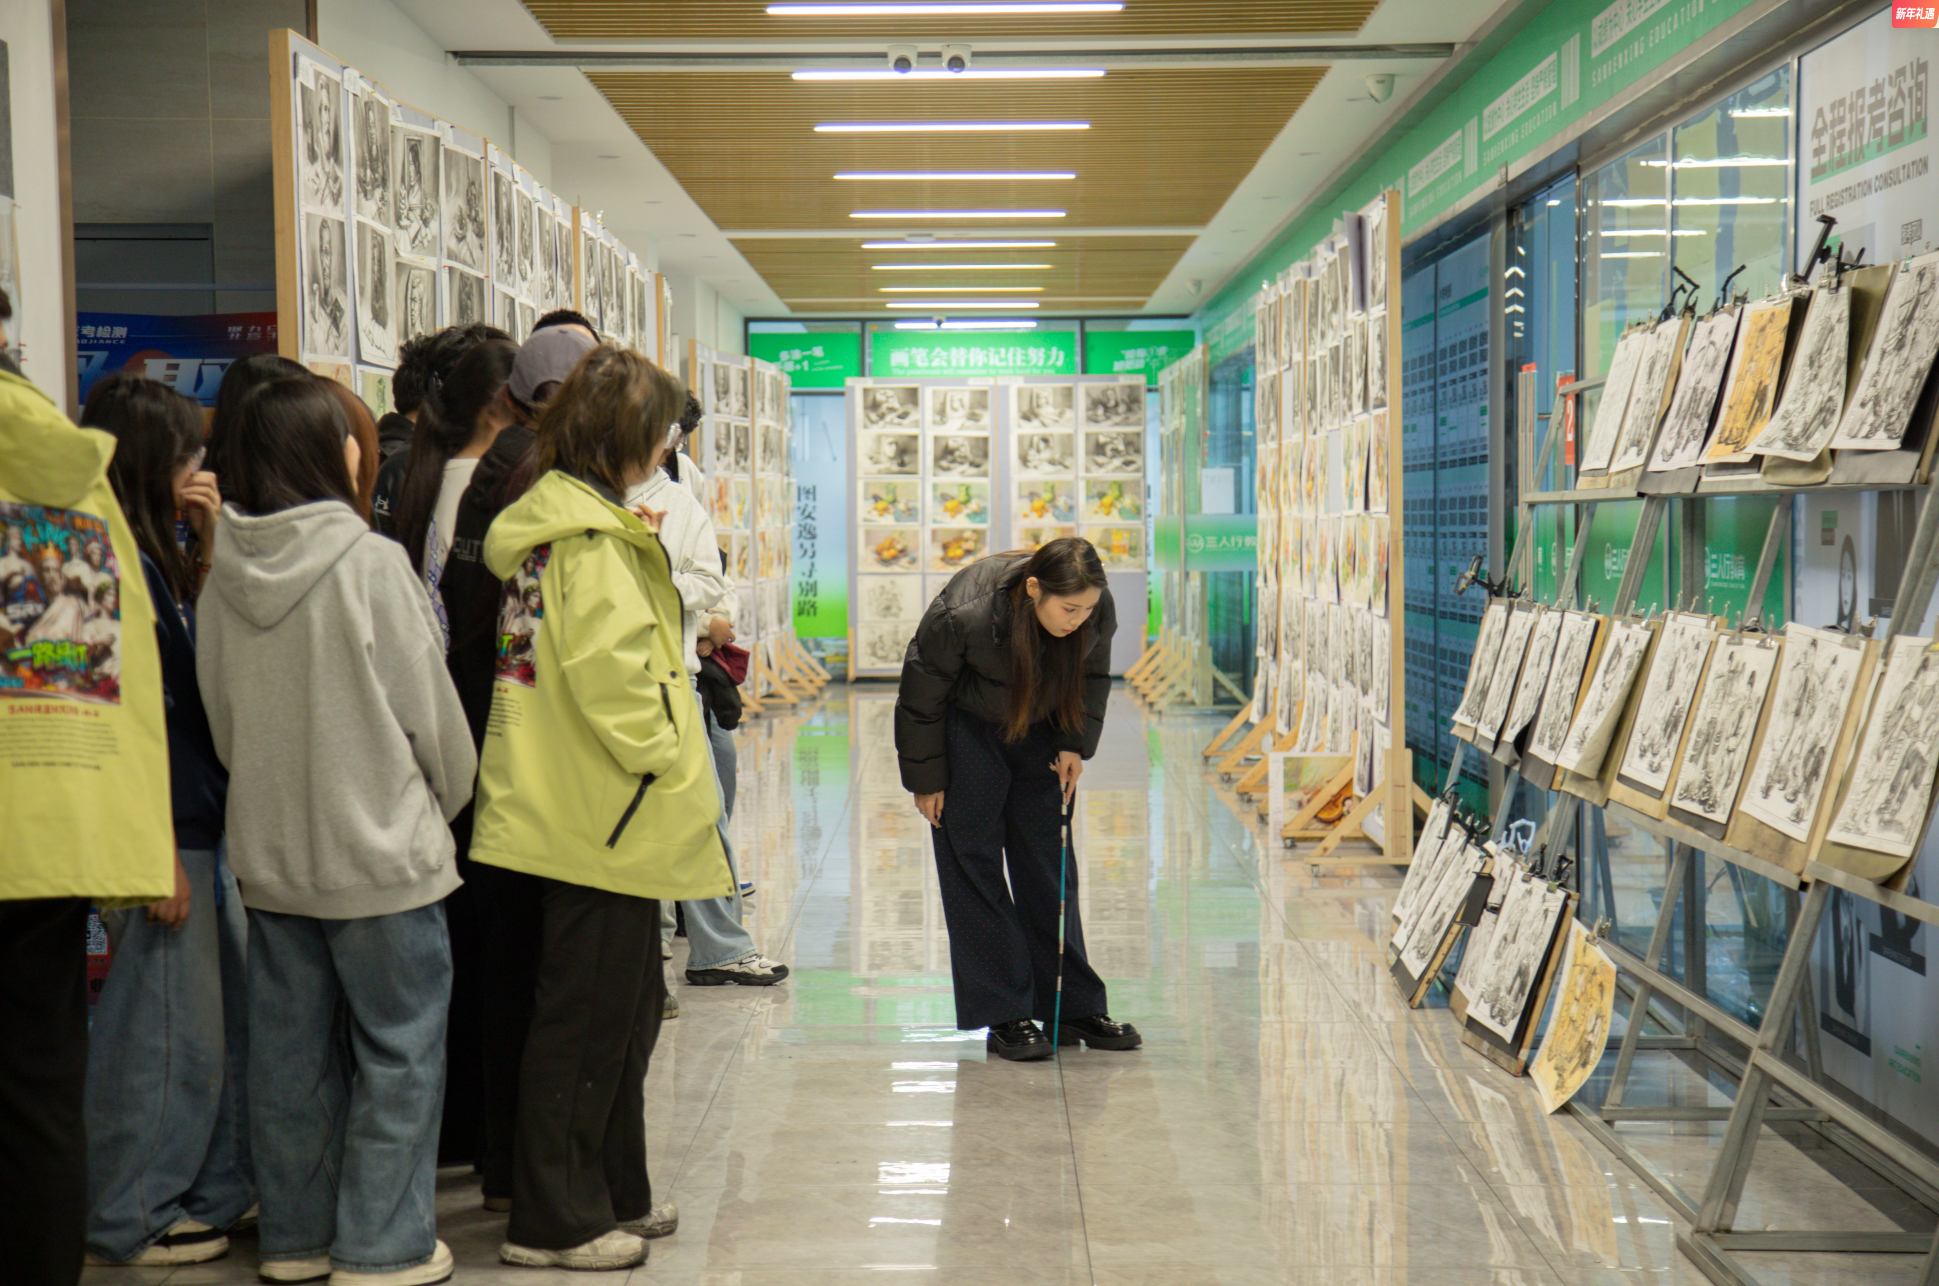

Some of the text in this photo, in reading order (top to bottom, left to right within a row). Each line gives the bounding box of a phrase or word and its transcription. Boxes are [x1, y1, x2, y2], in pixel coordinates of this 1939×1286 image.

[1810, 56, 1929, 180] 全程报考咨询
[1809, 154, 1929, 218] FULL REGISTRATION CONSULTATION
[890, 347, 1065, 367] 画笔会替你记住努力
